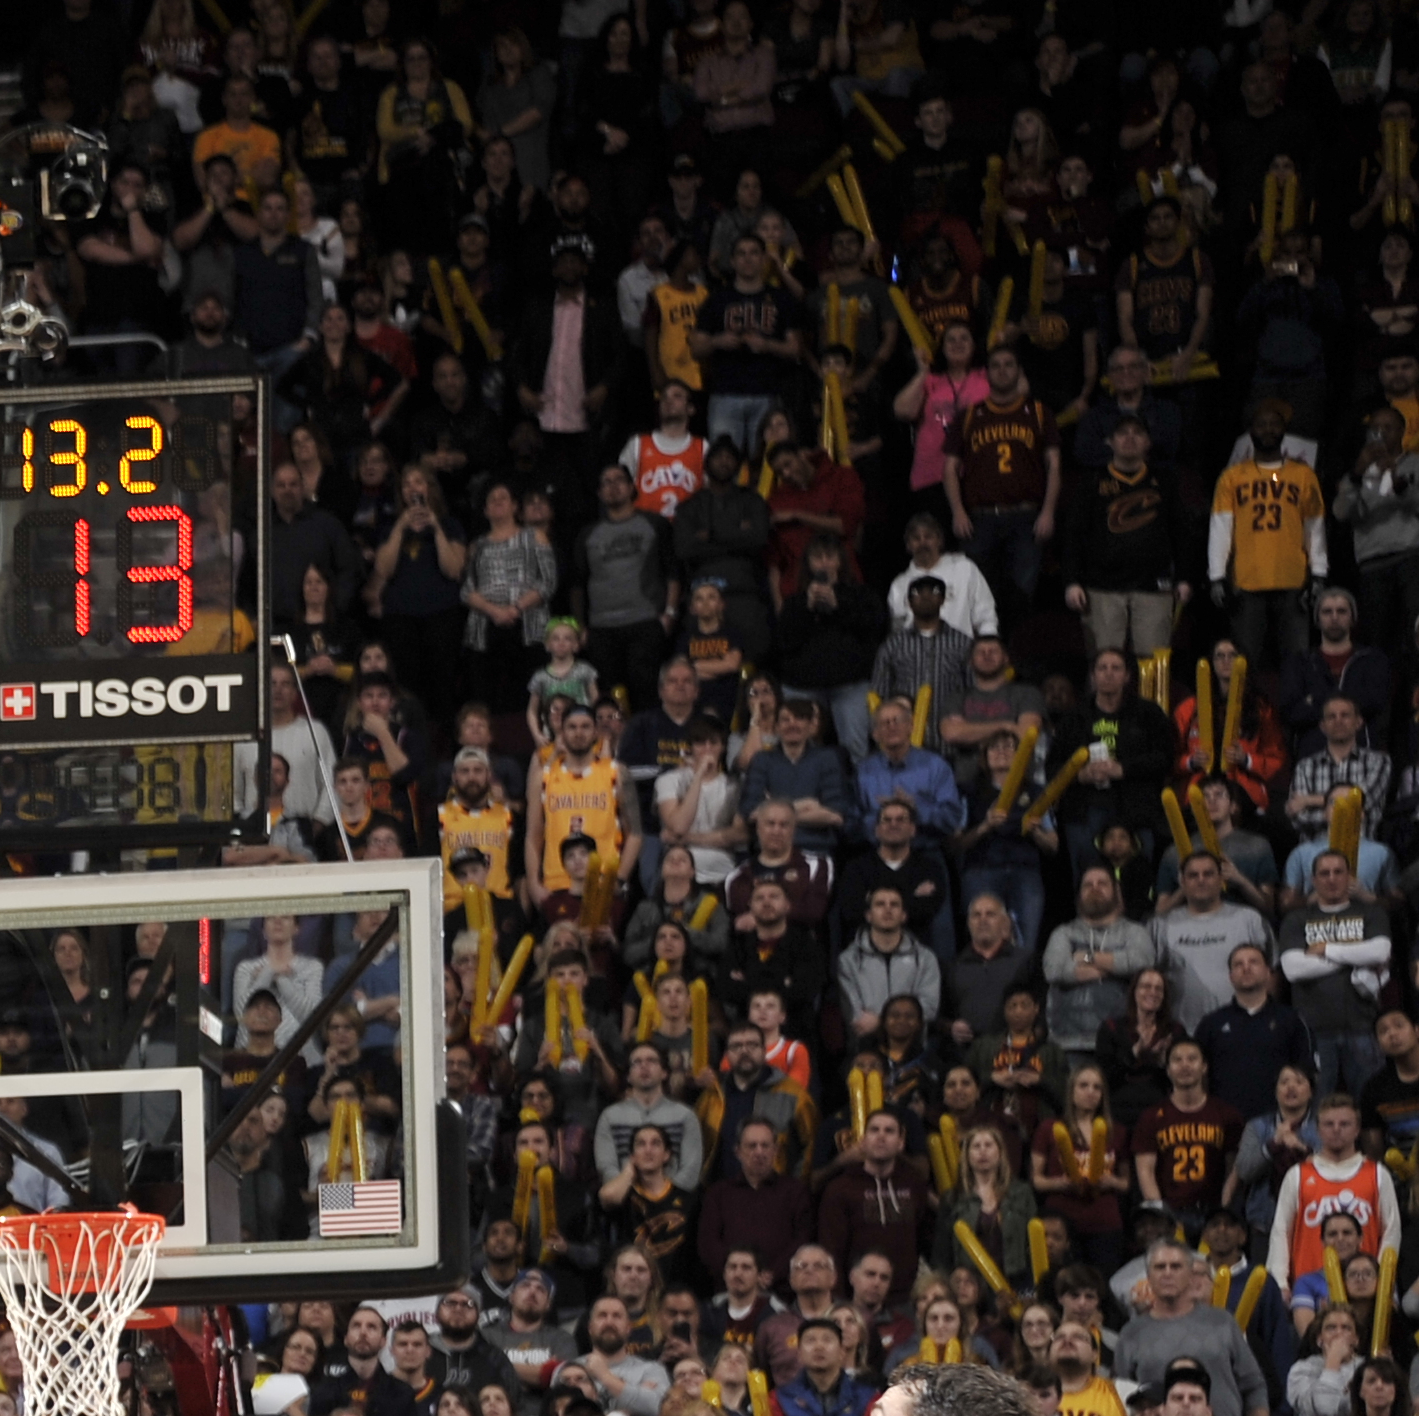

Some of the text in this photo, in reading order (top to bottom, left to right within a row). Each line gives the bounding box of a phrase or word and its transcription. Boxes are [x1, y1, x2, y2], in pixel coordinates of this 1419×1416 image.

[24, 415, 160, 498] 13.2
[997, 443, 1013, 473] 2
[1236, 480, 1301, 507] CAVS
[1252, 504, 1283, 532] 23
[74, 505, 192, 643] 13
[40, 675, 243, 718] TISSOT
[549, 792, 608, 811] CAVALIERS
[1157, 1123, 1224, 1151] CLEVELAND
[1173, 1144, 1207, 1182] 23
